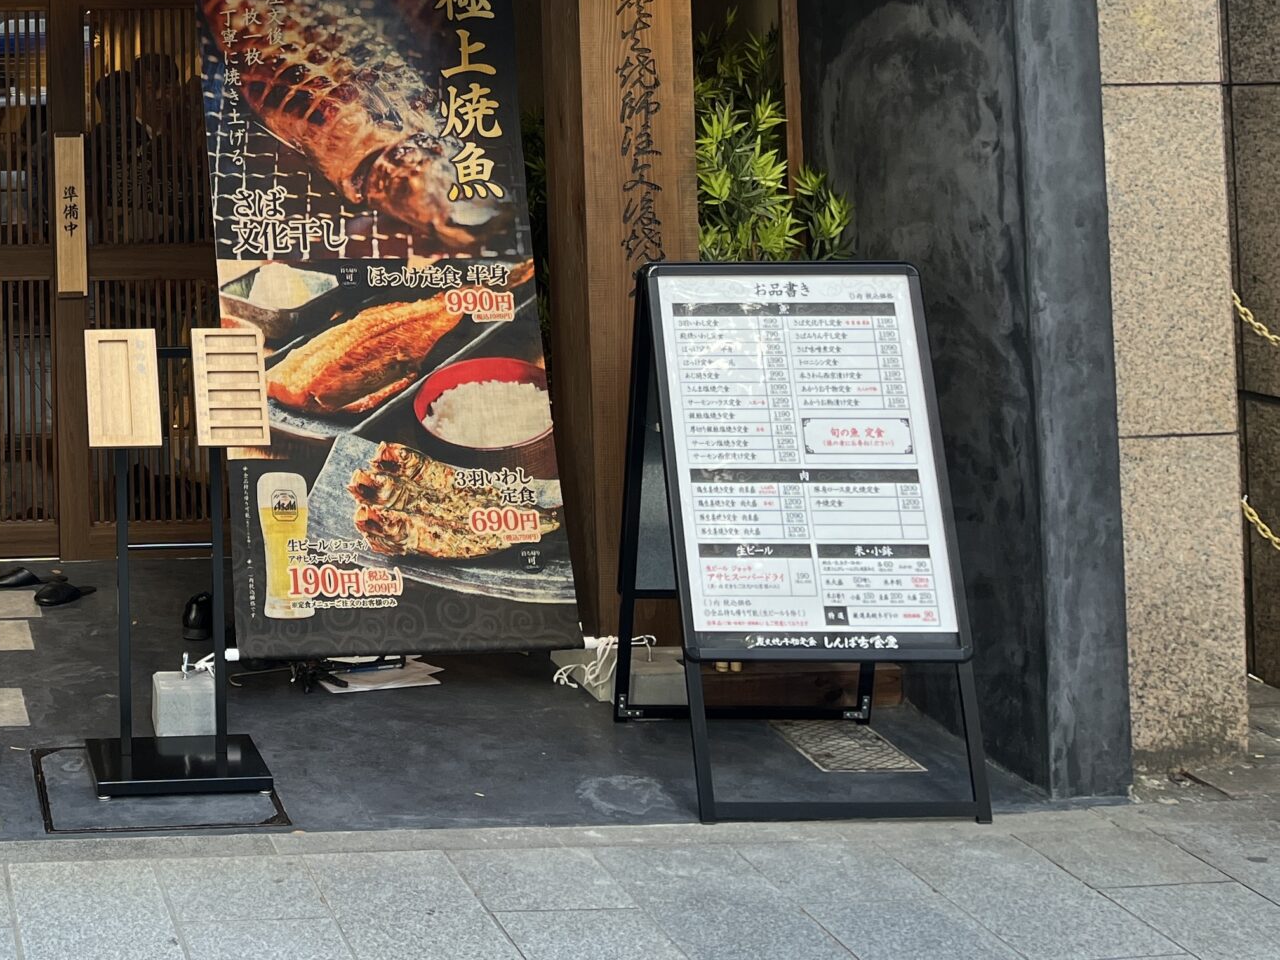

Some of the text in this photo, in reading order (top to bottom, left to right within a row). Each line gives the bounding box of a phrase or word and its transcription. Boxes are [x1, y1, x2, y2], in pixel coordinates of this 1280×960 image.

[220, 9, 246, 166] 丁寧に焼き上げる
[62, 186, 79, 237] 準備中
[232, 187, 286, 219] さば
[231, 219, 348, 254] 文化干し
[367, 265, 509, 287] ほっけ定食 半身
[754, 282, 811, 298] お品書き
[447, 291, 512, 313] 990円
[865, 427, 885, 438] 定食
[456, 468, 532, 487] 3羽いわし
[501, 487, 535, 504] 定食
[471, 509, 538, 532] 690円
[736, 546, 773, 556] 生ビール
[289, 566, 361, 596] 190円
